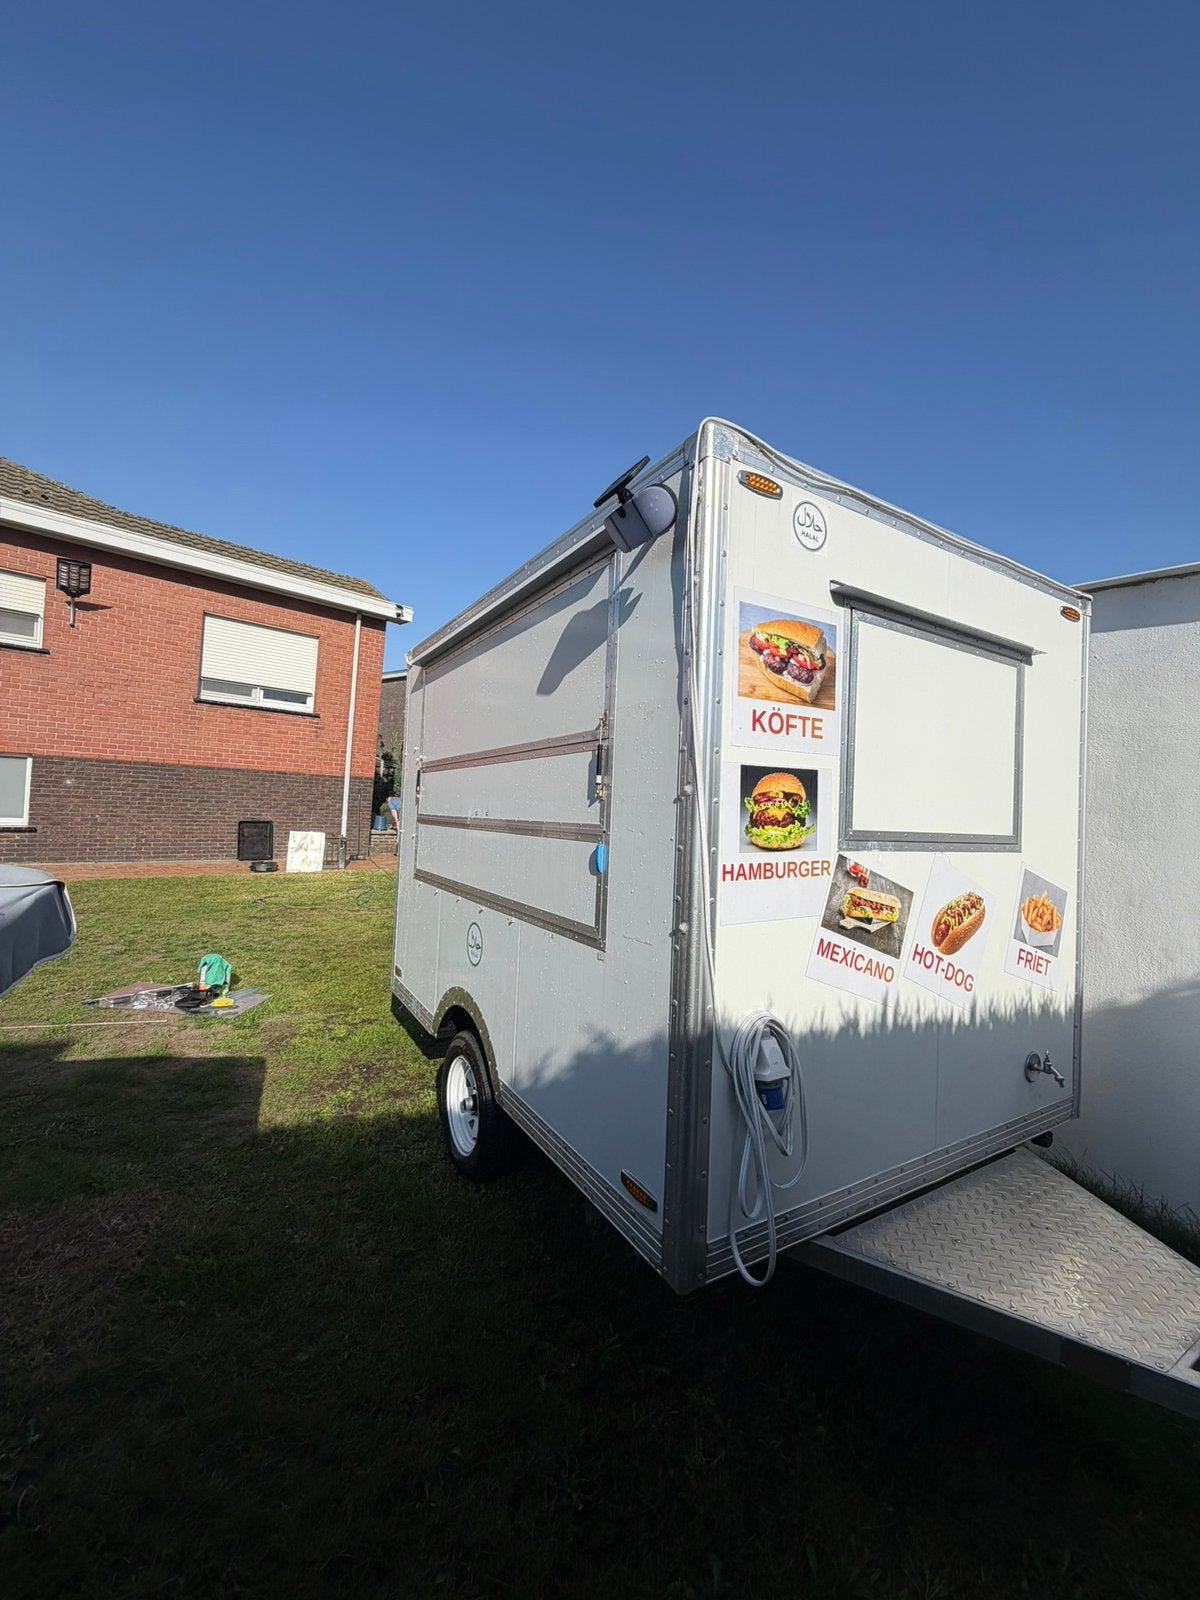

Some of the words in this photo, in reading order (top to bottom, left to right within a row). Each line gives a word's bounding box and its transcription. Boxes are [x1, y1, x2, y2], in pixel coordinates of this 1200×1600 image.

[801, 530, 819, 543] HALAL
[751, 706, 824, 740] KÖFTE
[722, 860, 831, 882] HAMBURGER
[912, 943, 975, 993] HOT-DOG
